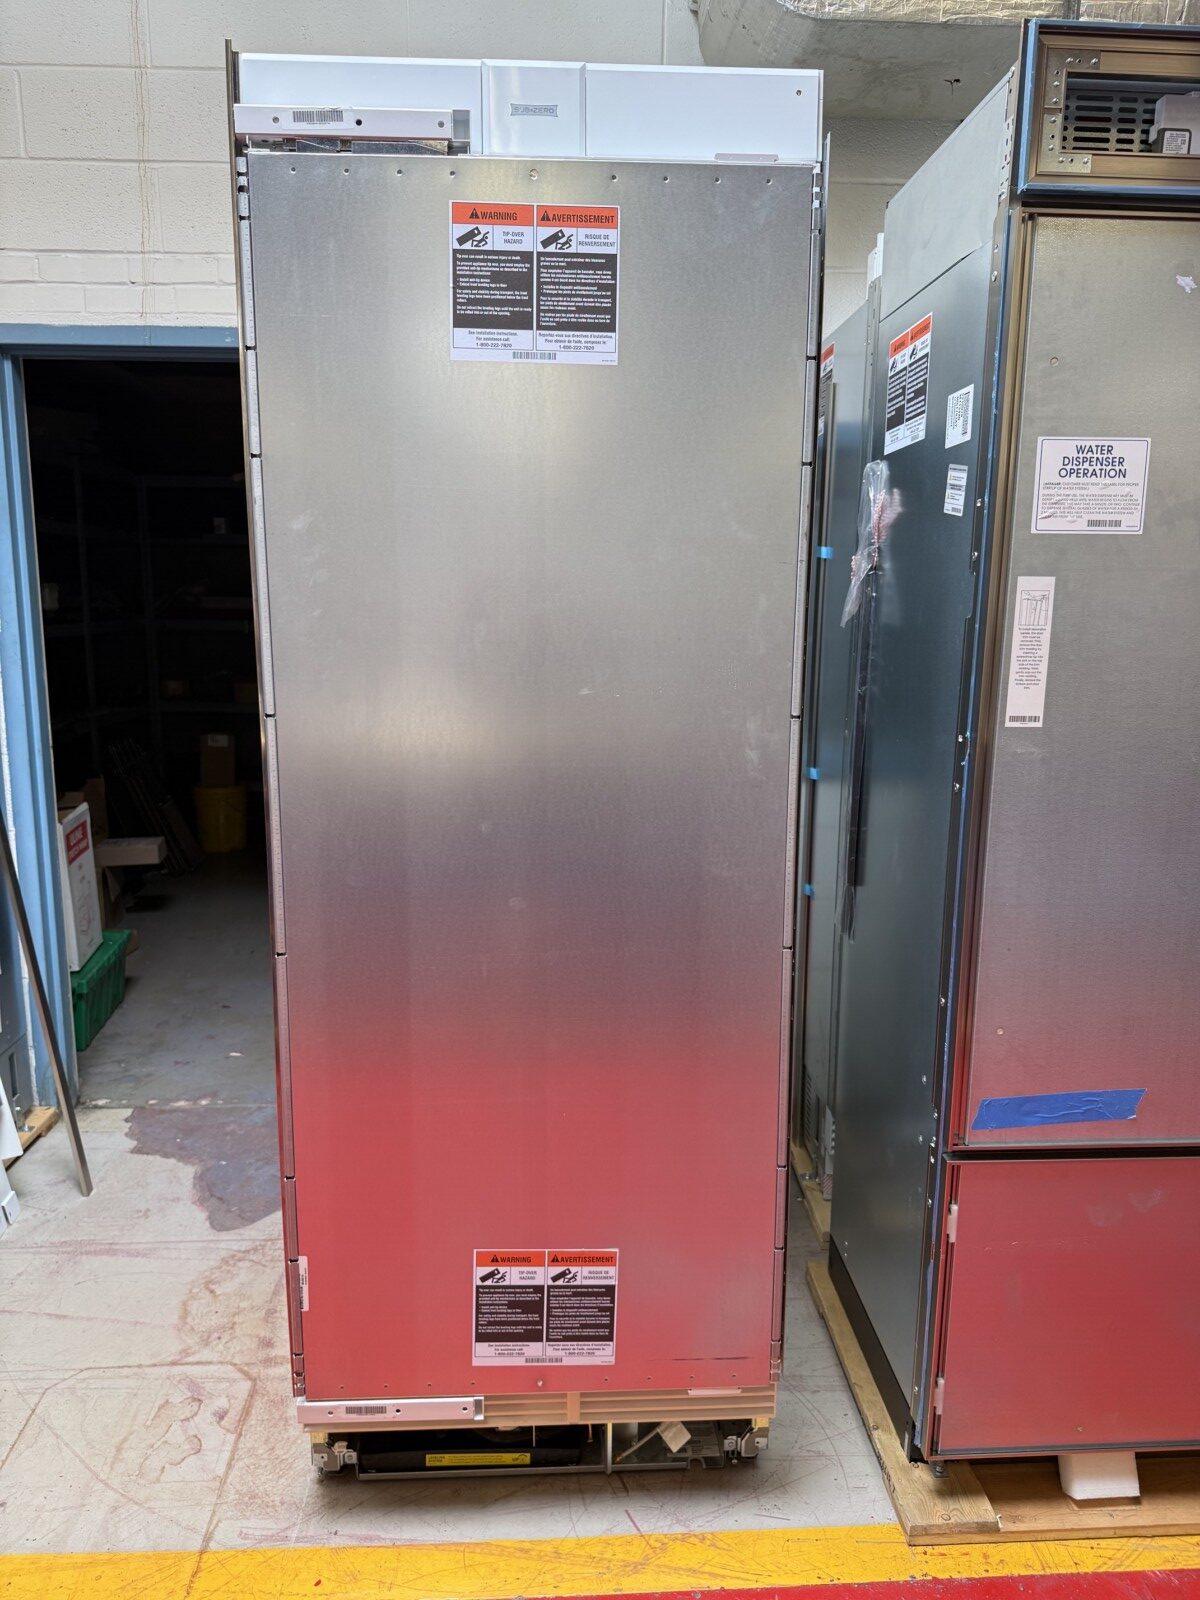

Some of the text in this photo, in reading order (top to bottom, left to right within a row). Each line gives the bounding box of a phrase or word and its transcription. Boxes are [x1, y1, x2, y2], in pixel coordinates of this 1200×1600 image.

[481, 212, 517, 220] WARNING
[552, 214, 614, 223] AVERTISSEMENT
[1076, 445, 1113, 455] WATER
[1063, 456, 1124, 466] DISPENSER
[1058, 468, 1126, 478] OPERATION
